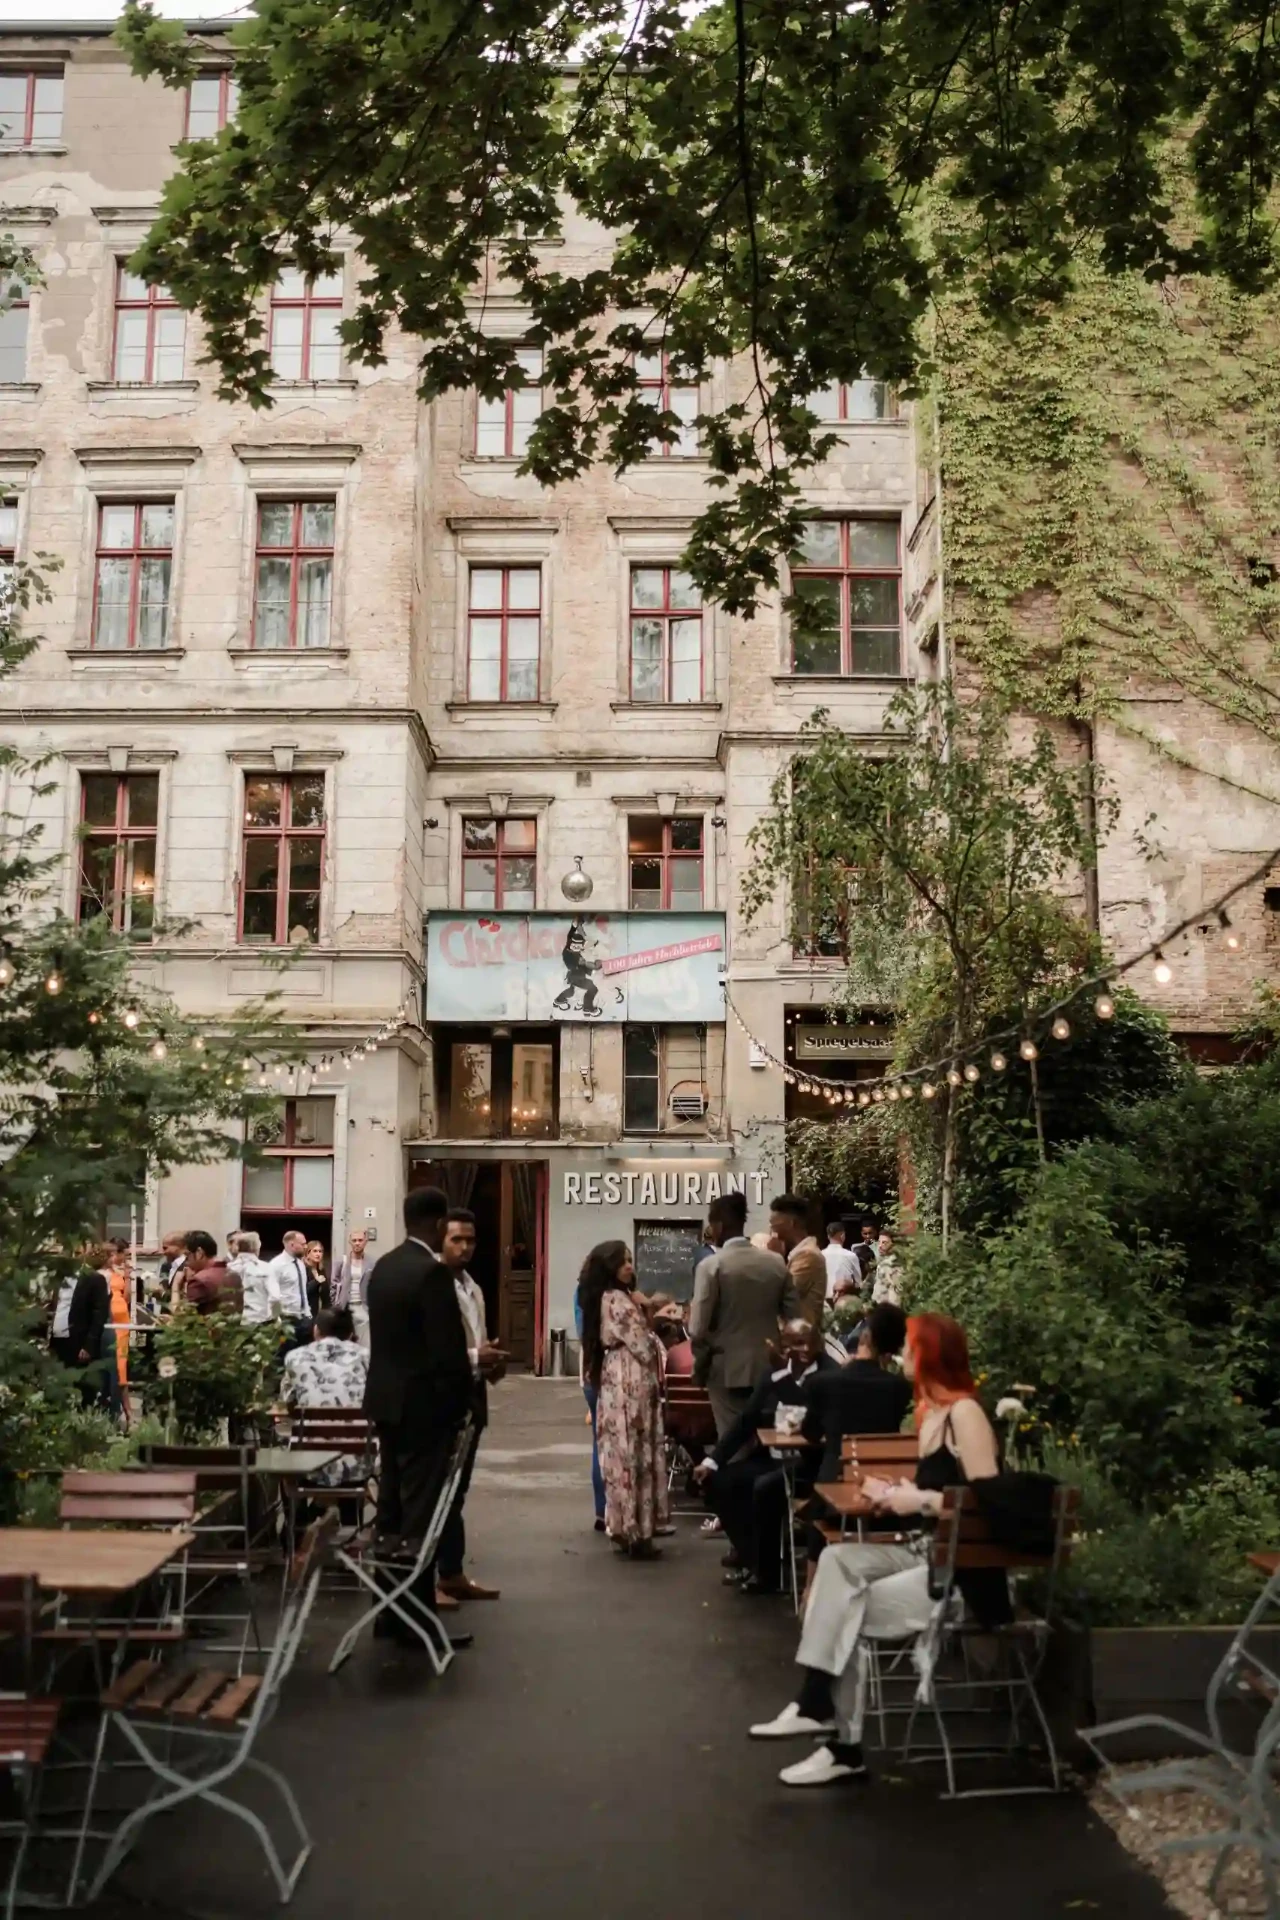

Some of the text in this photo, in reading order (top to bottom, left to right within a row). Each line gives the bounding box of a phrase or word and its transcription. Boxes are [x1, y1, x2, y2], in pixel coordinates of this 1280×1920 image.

[608, 959, 626, 971] 100
[629, 953, 654, 967] Jahre
[564, 1172, 769, 1205] RESTAURANT
